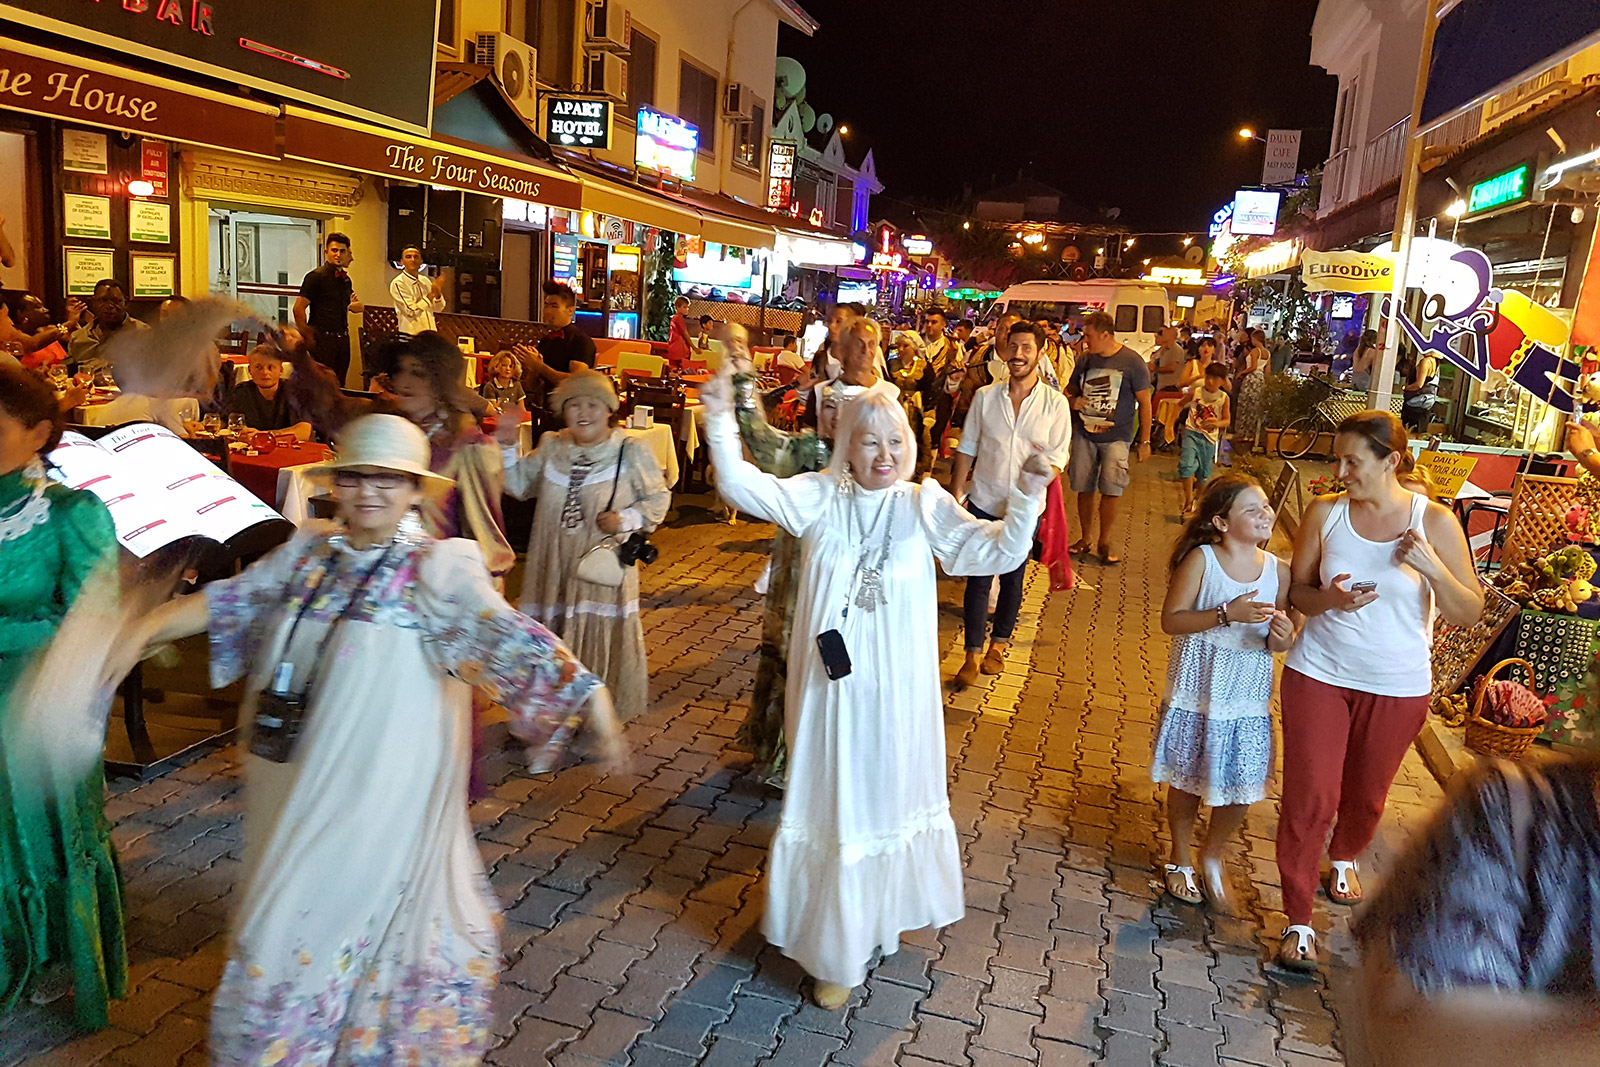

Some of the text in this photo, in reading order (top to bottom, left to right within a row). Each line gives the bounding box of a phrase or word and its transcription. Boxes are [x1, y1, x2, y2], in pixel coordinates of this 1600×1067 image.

[43, 72, 158, 122] House
[553, 101, 603, 118] APART
[551, 120, 603, 136] HOTEL
[386, 144, 541, 197] The Four Seasons
[1309, 262, 1390, 277] EuroDive
[1433, 456, 1459, 465] DAILY
[1434, 464, 1449, 475] TOUR
[1449, 467, 1468, 477] ALSO
